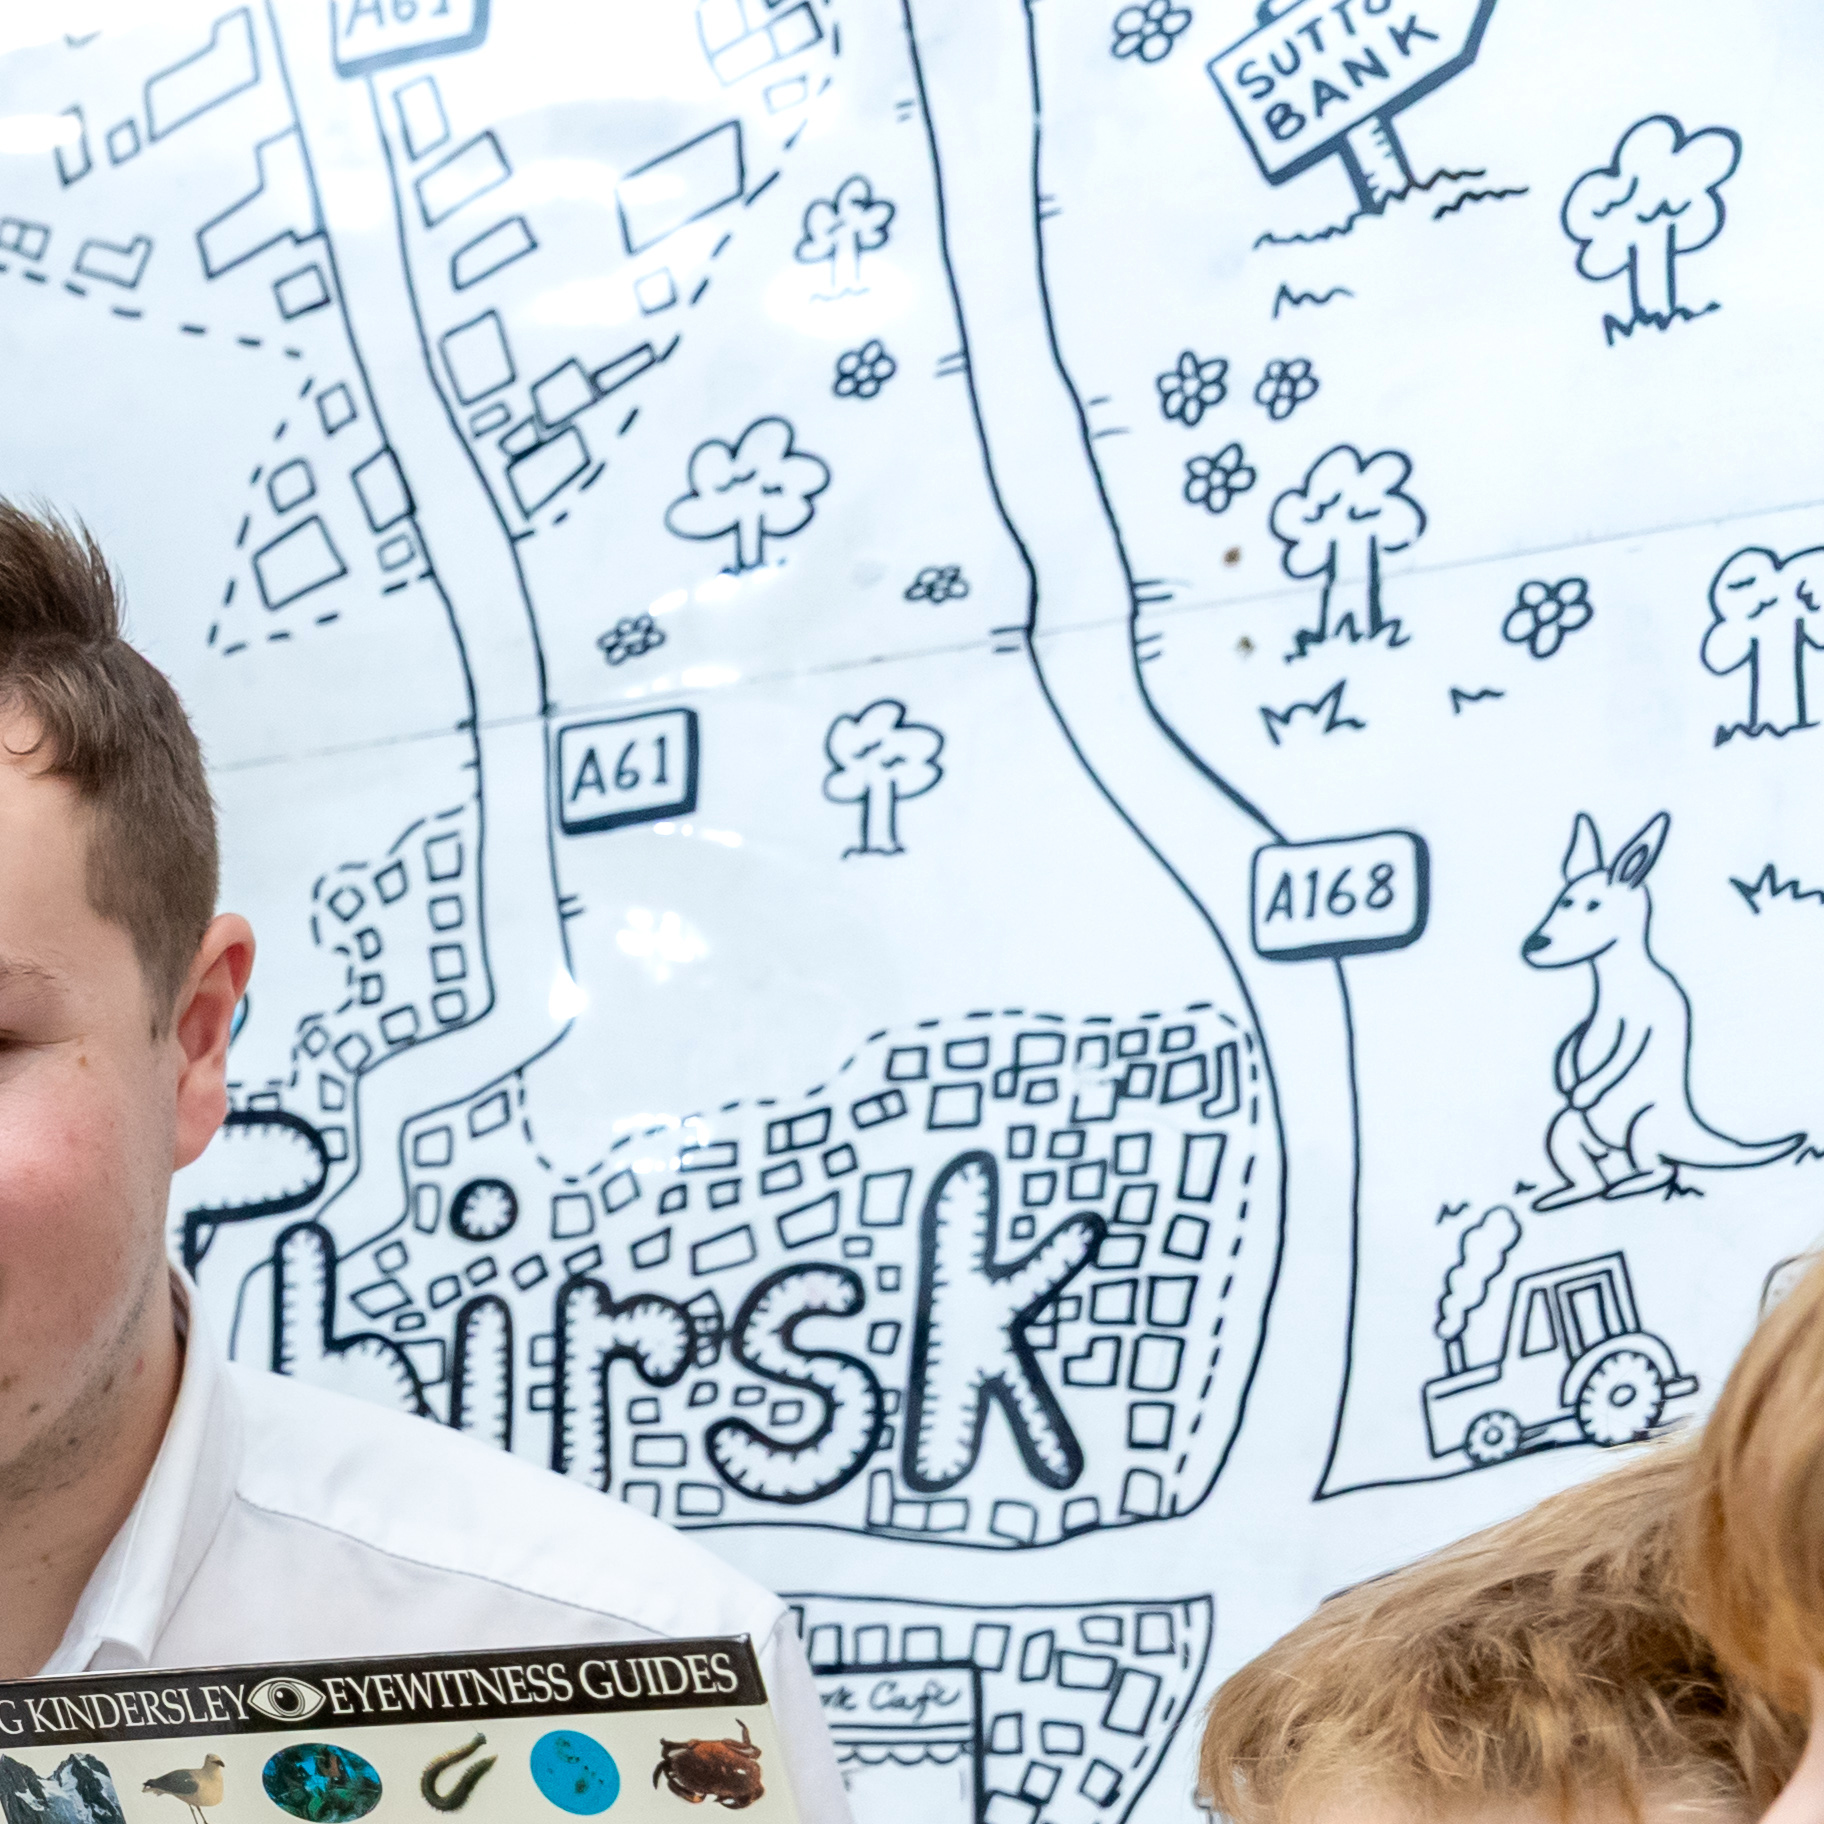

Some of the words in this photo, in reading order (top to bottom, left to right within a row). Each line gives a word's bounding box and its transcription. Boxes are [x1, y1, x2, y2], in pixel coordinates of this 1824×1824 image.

[1264, 14, 1440, 141] BANK
[568, 736, 670, 801] A61
[1263, 864, 1396, 925] A168
[25, 1683, 249, 1733] KINDERSLEY
[325, 1664, 573, 1721] EYEWITNESS
[582, 1651, 739, 1706] GUIDES
